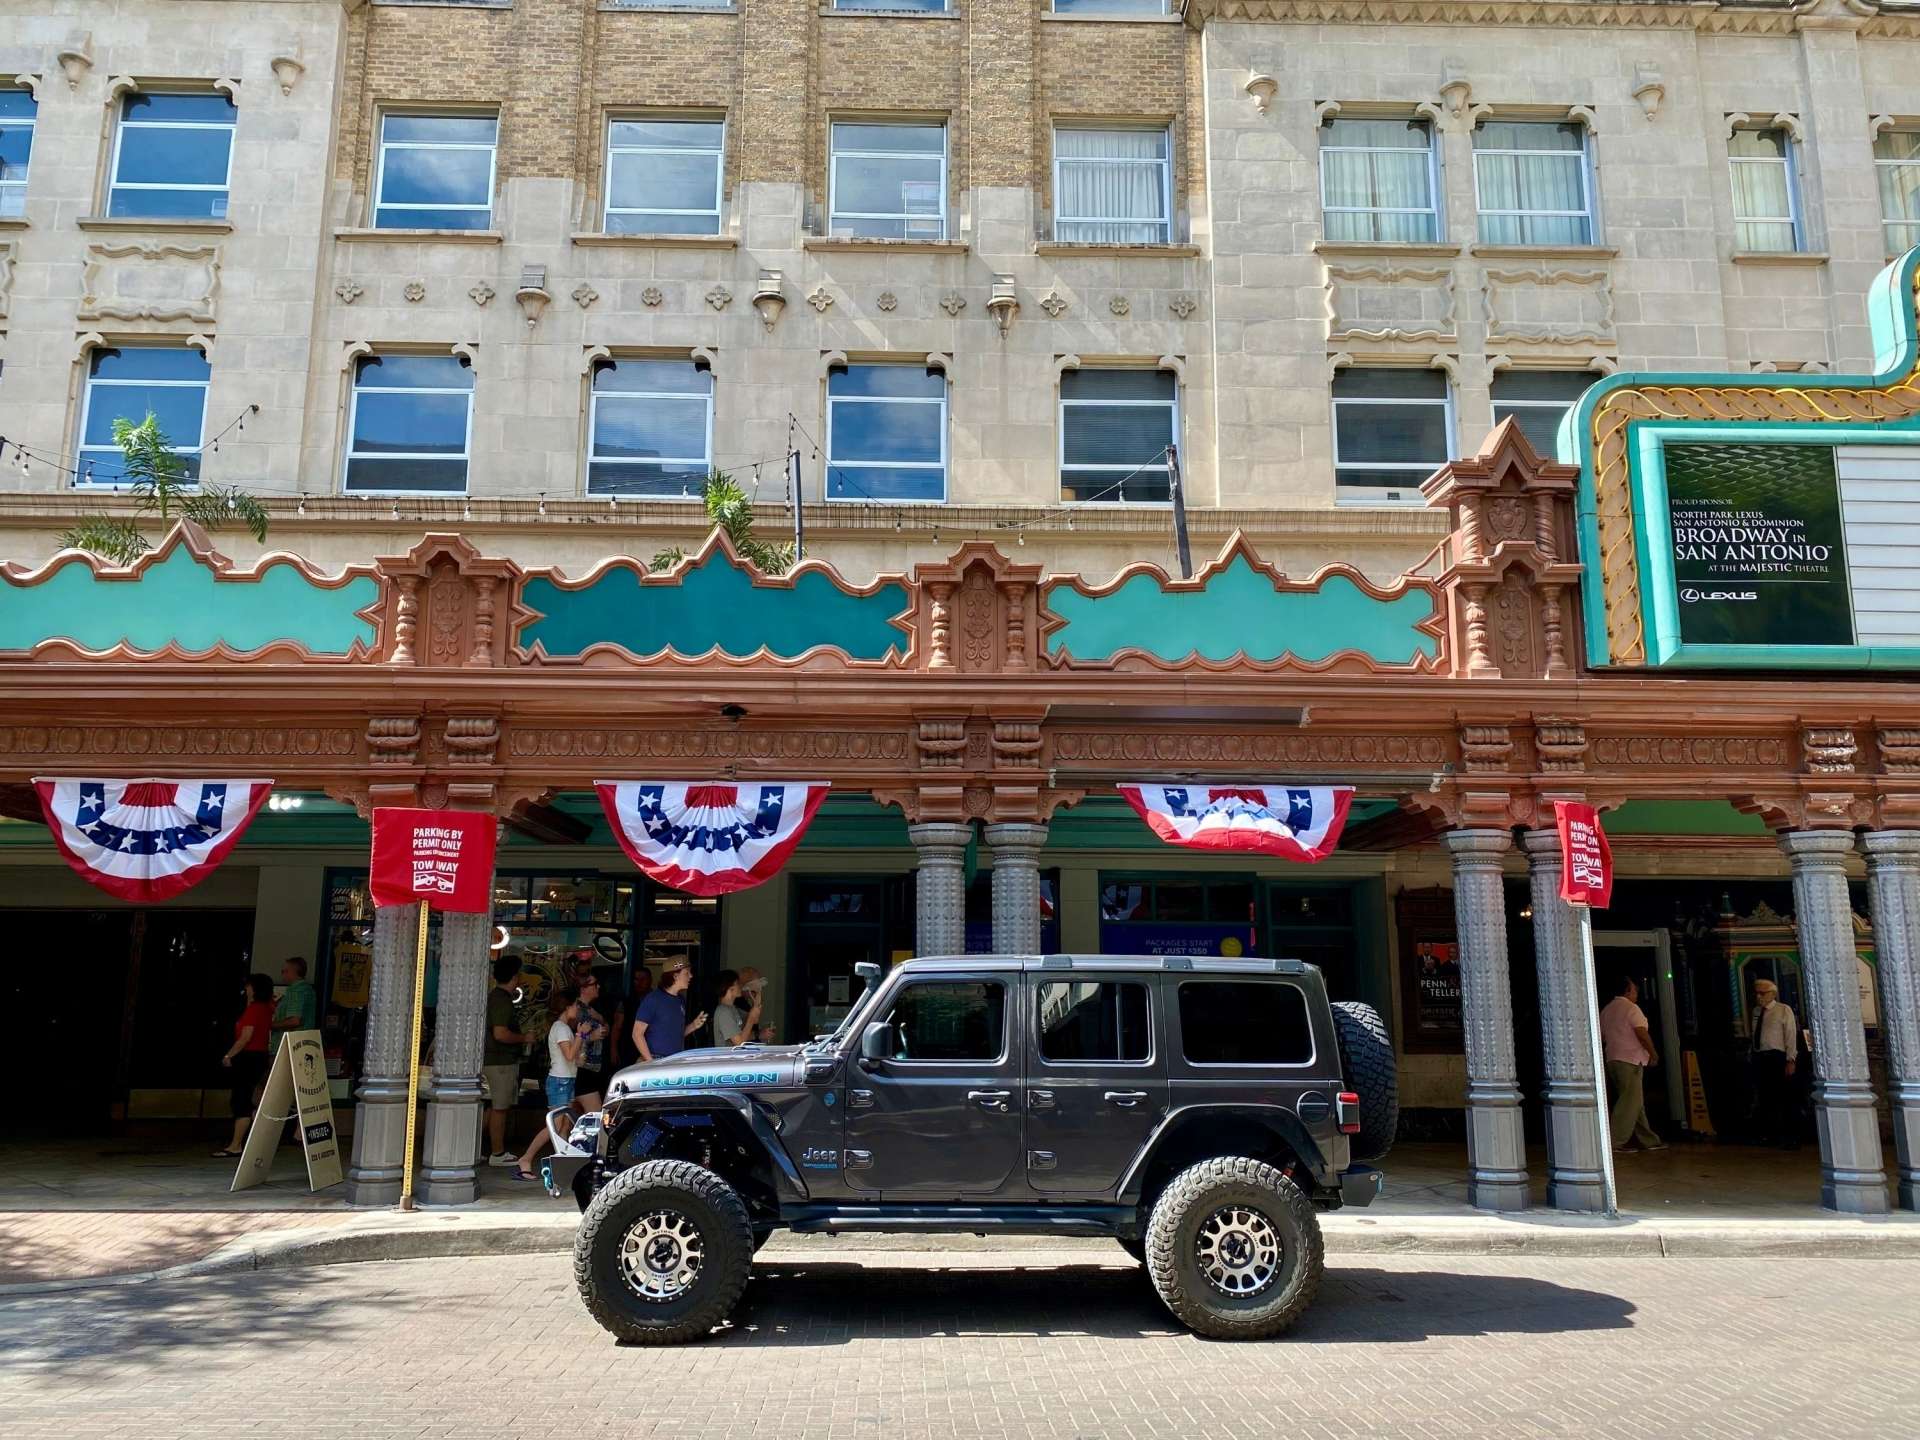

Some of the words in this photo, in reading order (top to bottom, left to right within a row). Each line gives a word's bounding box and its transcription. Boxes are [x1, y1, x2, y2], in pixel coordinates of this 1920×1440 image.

[1673, 511, 1707, 519] NORTH
[1710, 511, 1733, 519] PARK
[1736, 511, 1763, 519] LEXUS
[1673, 519, 1691, 527] SAN
[1694, 519, 1740, 527] ANTONIO
[1742, 519, 1750, 527] &
[1752, 519, 1804, 527] DOMINION
[1676, 528, 1790, 543] BROADWAY
[1793, 534, 1806, 543] IN
[1676, 544, 1717, 560] SAN
[1708, 564, 1718, 572] AT
[1721, 564, 1736, 572] THE
[1740, 563, 1792, 574] MAJESTIC
[1795, 564, 1829, 573] THEATRE
[1700, 591, 1758, 600] LEXUS
[413, 828, 450, 838] PARKING
[451, 830, 463, 839] BY
[412, 838, 441, 849] PERMIT
[441, 839, 462, 851] ONLY
[412, 860, 434, 870] TOW
[1164, 947, 1186, 955] JUST
[1420, 980, 1447, 989] PENN
[1429, 988, 1460, 997] TELLER
[640, 1072, 780, 1088] RUBICON
[802, 1147, 838, 1162] Jeep
